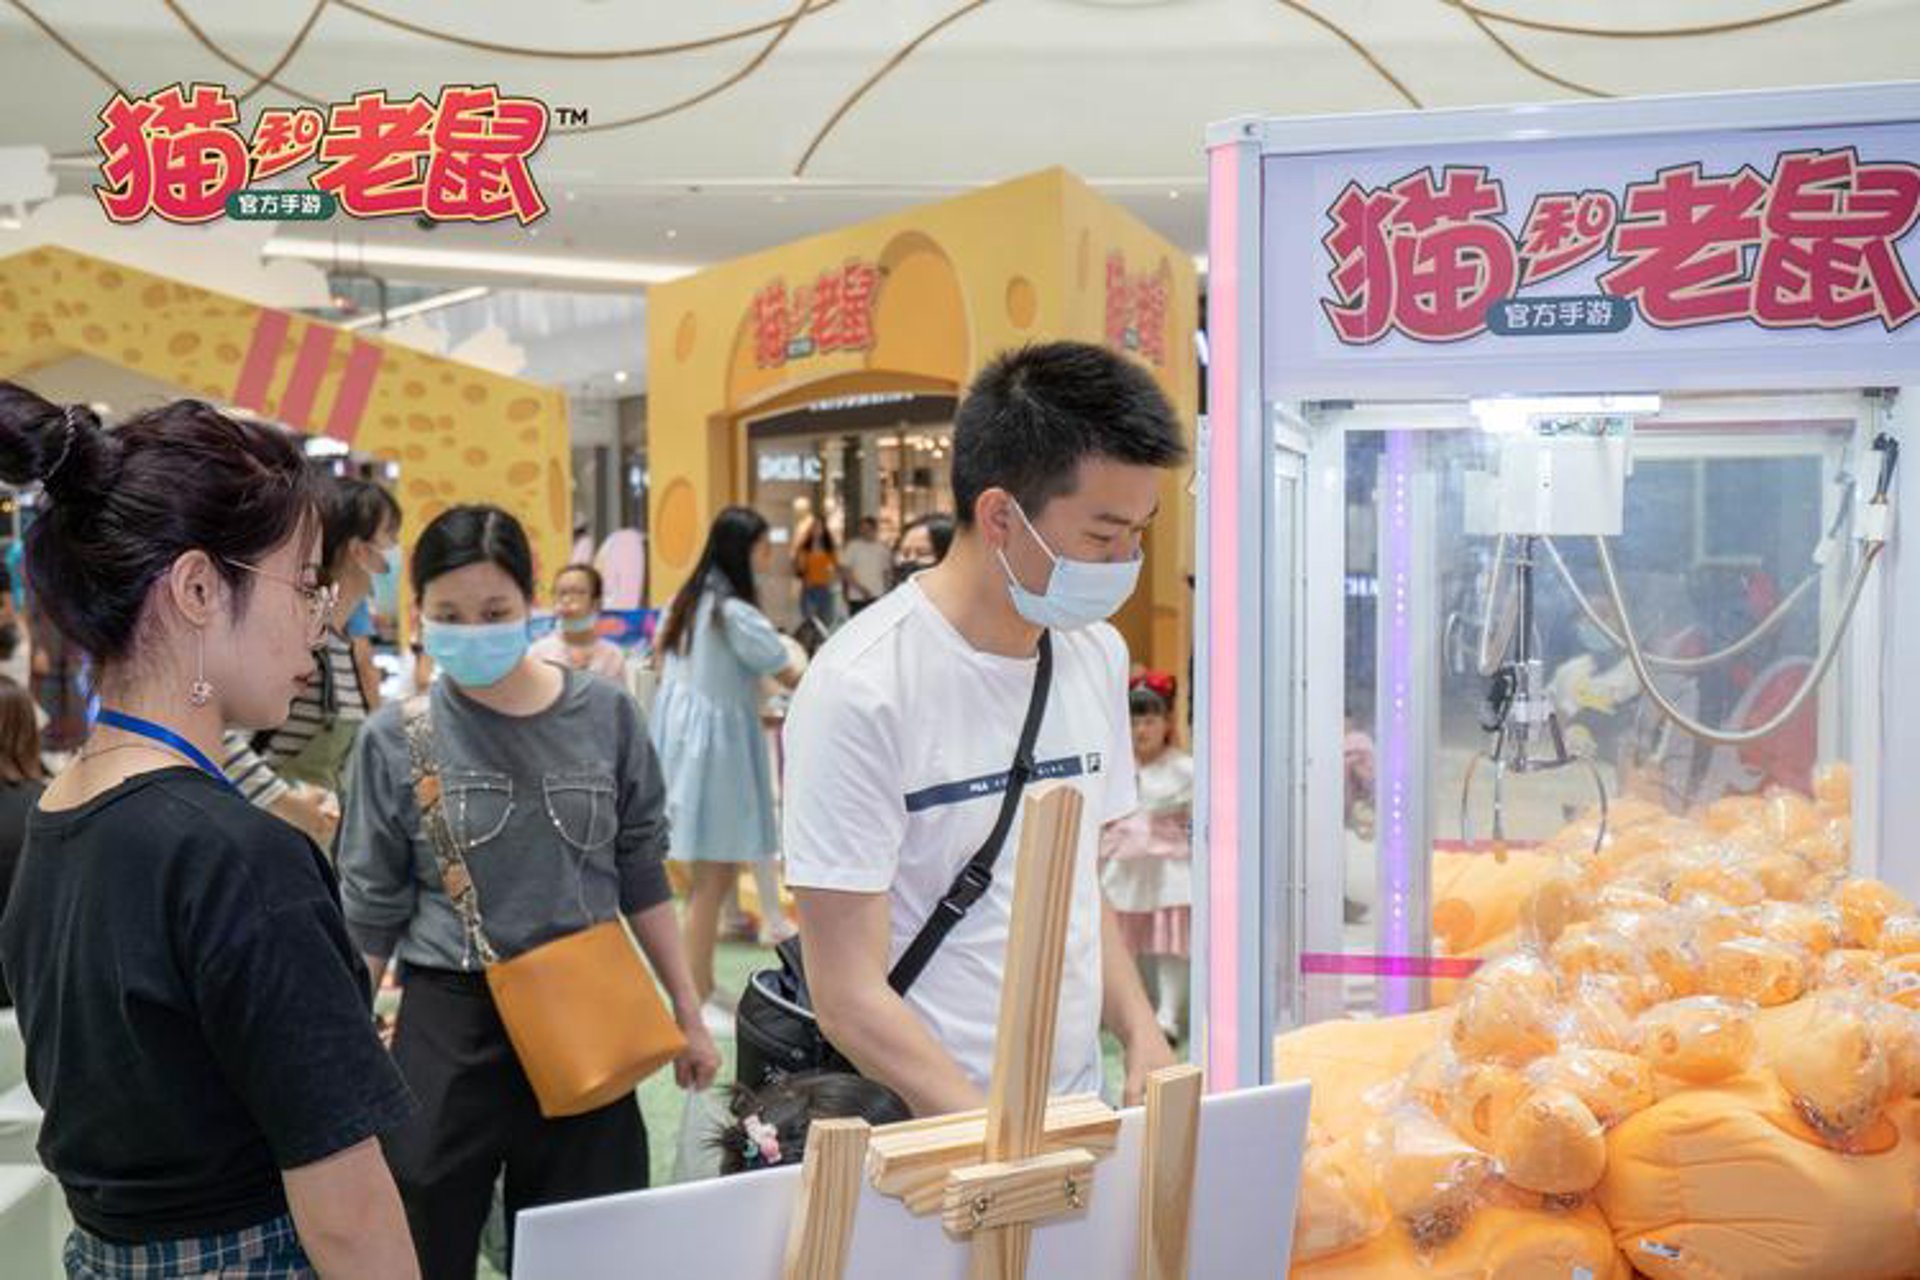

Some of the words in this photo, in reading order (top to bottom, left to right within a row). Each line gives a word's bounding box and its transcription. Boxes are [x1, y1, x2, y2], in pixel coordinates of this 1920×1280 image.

[1320, 146, 1920, 346] 猫和老鼠
[1503, 301, 1616, 328] 官方手游
